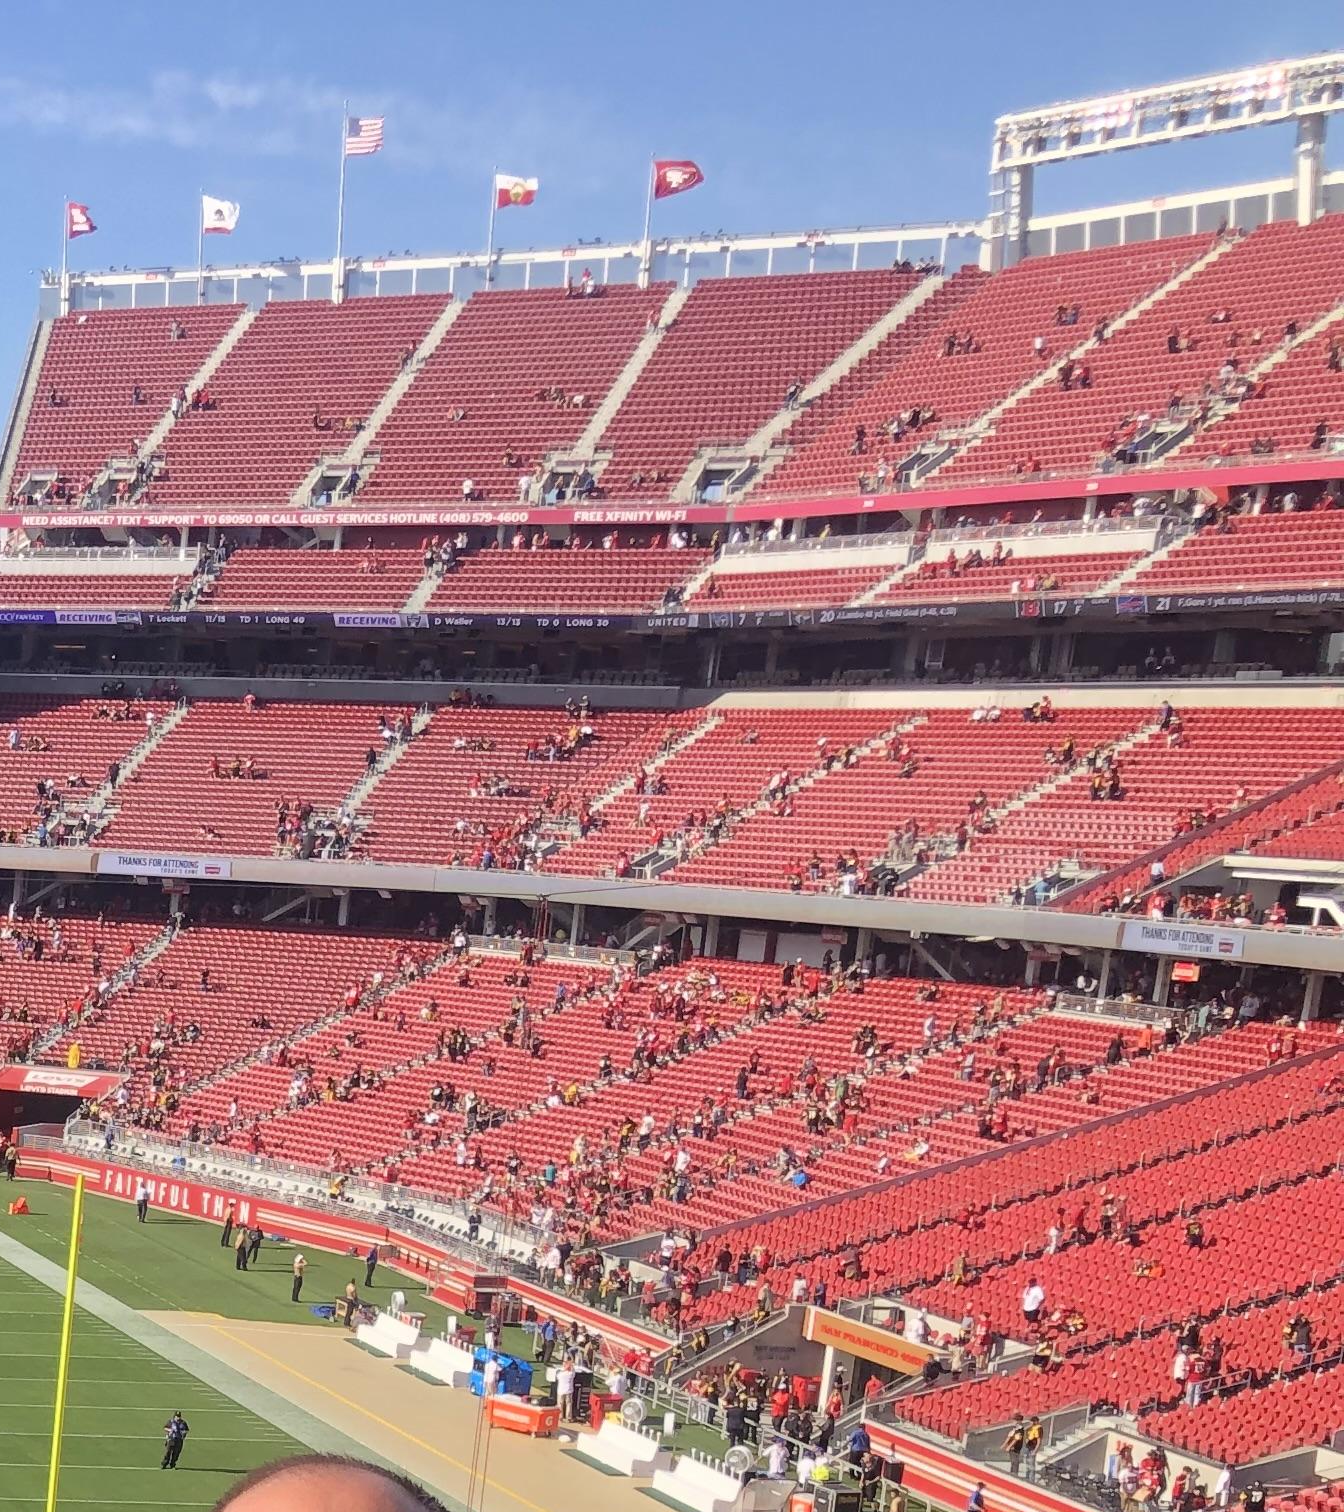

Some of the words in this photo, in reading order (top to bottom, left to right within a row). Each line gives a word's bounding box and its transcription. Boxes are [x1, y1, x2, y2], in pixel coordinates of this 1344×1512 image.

[22, 515, 48, 525] NEED
[50, 515, 113, 525] ASSISTANCE?
[116, 515, 141, 525] TEXT
[203, 515, 217, 525] TO
[218, 515, 252, 525] 69050
[255, 514, 270, 524] OR
[272, 514, 299, 524] CALL
[301, 514, 334, 524] GUEST
[336, 513, 388, 524] SERVICES
[389, 512, 438, 524] HOTLINE
[439, 512, 471, 524] (408)
[472, 511, 528, 524] 579-4600
[573, 511, 603, 522] FREE
[604, 511, 652, 522] XFINITY
[654, 510, 687, 521] WI-FI
[1053, 600, 1066, 615] 17
[1156, 597, 1171, 612] 21
[16, 613, 45, 622] FANTASY
[59, 614, 113, 623] RECEIVING
[148, 615, 155, 623] T
[240, 616, 252, 624] TD
[265, 616, 290, 624] LONG
[338, 616, 397, 626] RECEIVING
[537, 619, 550, 627] TD
[566, 619, 593, 627] LONG
[596, 619, 609, 627] 30
[647, 617, 687, 628] UNITED
[738, 613, 746, 626] 7
[820, 611, 835, 623] 20
[118, 856, 147, 867] THANKS
[148, 857, 162, 868] FOR
[163, 859, 199, 869] ATTENDING
[1141, 926, 1168, 941] THANKS
[1168, 928, 1181, 942] FOR
[1182, 930, 1214, 945] ATTENDING
[202, 1192, 250, 1224] THN
